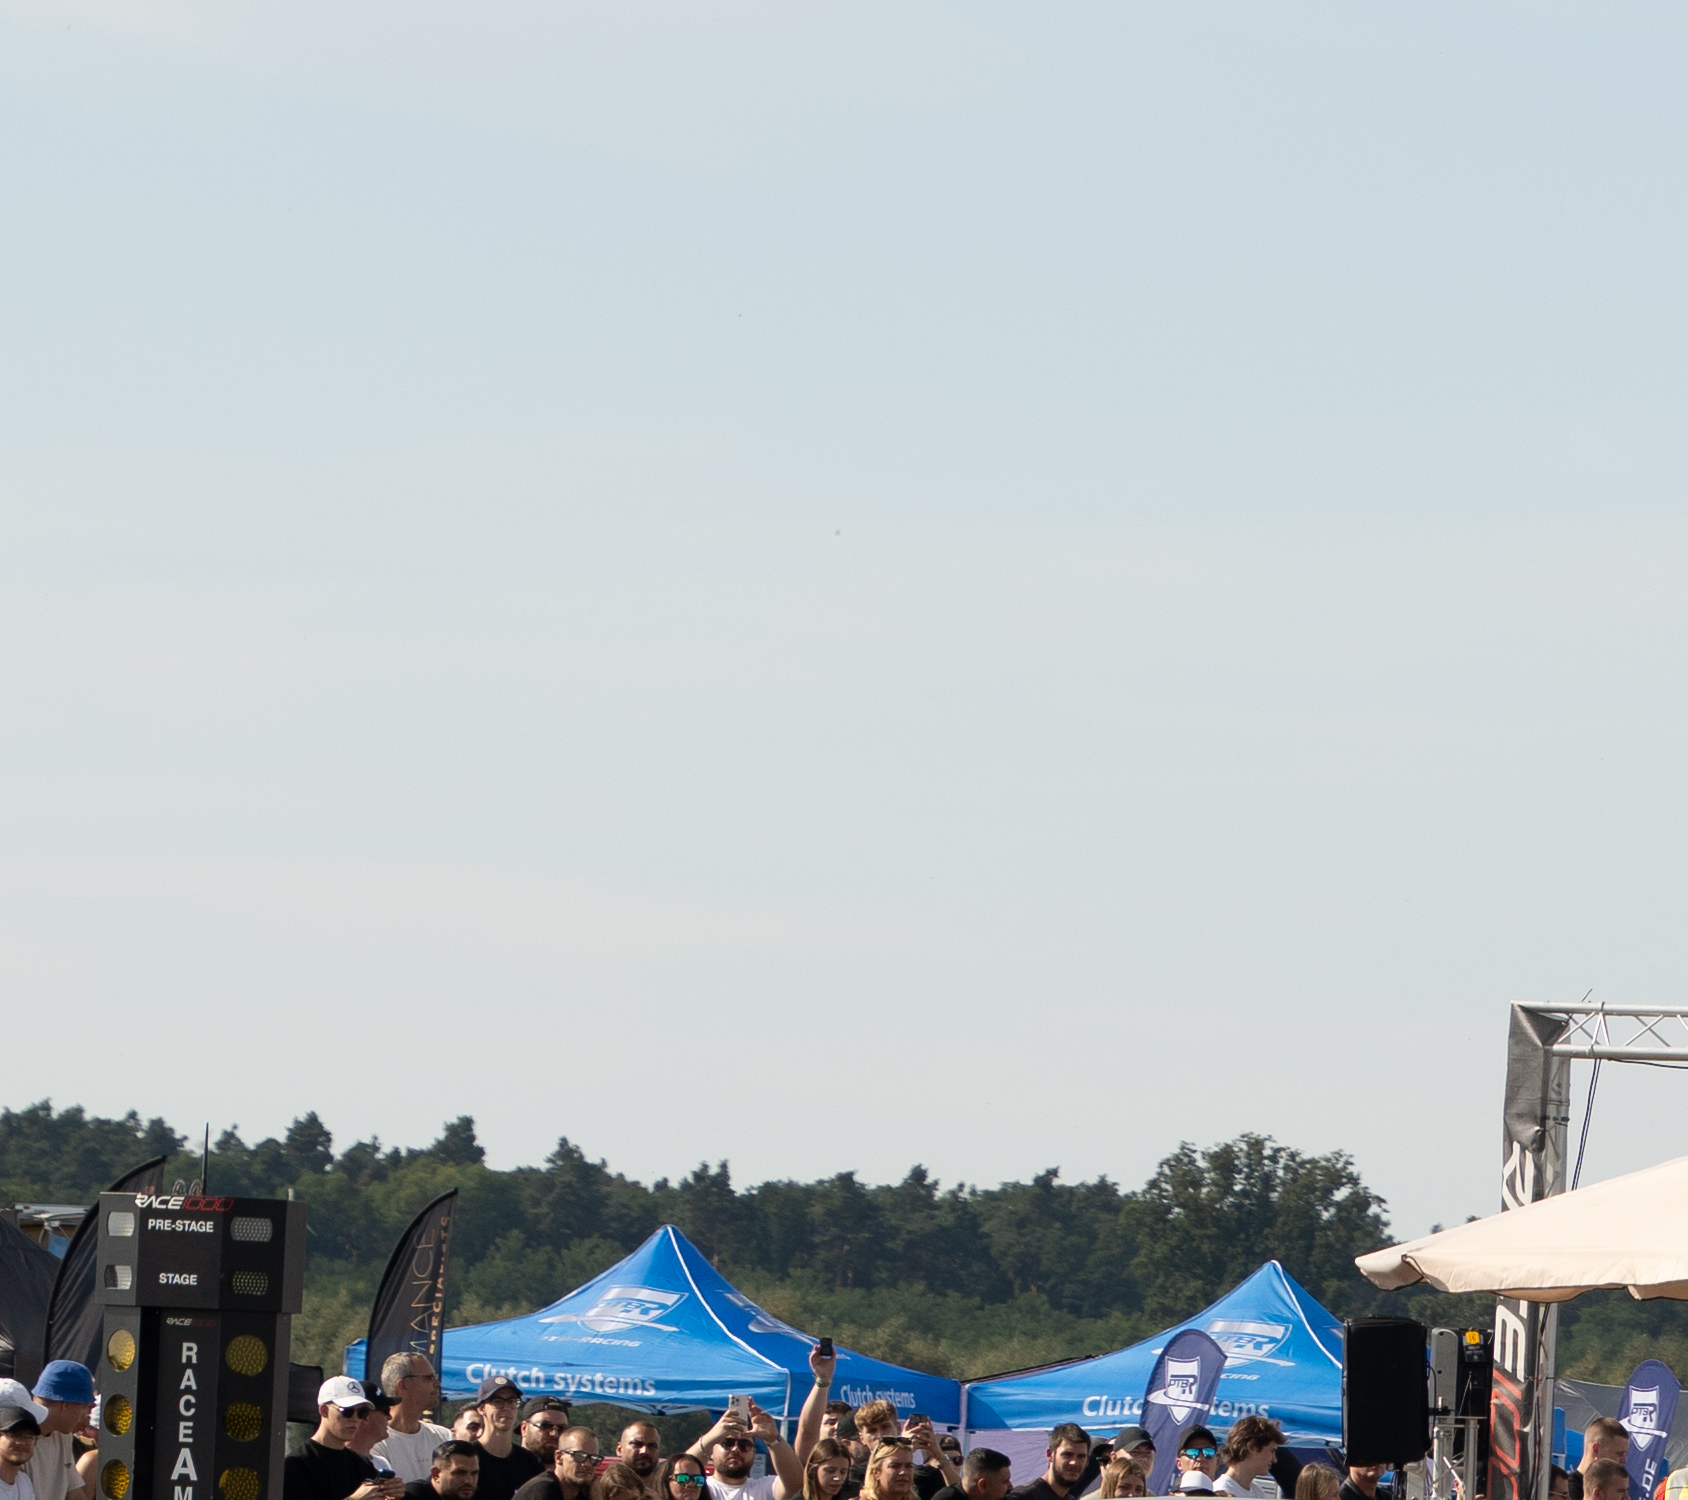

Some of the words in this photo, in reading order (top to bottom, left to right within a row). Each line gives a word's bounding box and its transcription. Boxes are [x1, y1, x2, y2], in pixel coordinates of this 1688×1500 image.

[134, 1193, 234, 1211] RACE1000
[148, 1219, 214, 1232] PRE-STAGE
[159, 1273, 197, 1285] STAGE
[465, 1363, 545, 1388] Clutch
[553, 1372, 656, 1396] systems
[1082, 1395, 1144, 1417] Clutc
